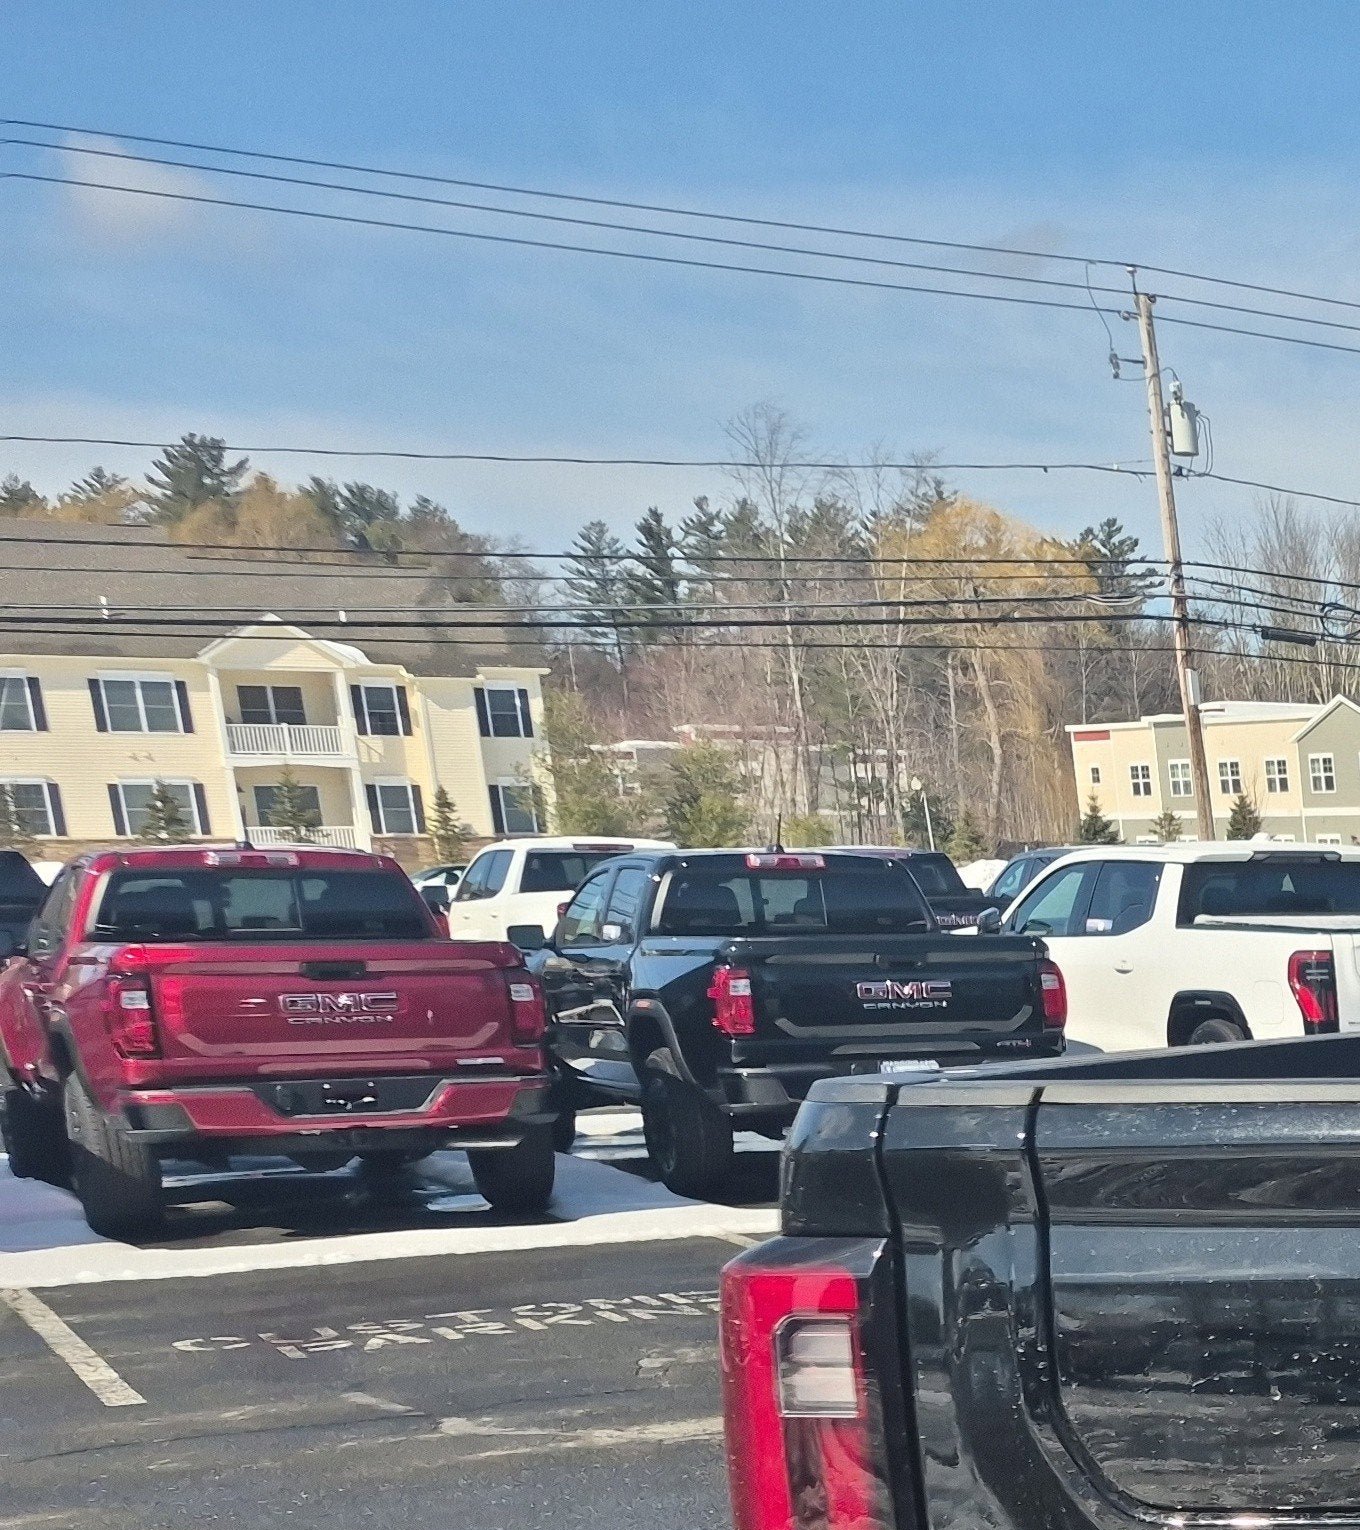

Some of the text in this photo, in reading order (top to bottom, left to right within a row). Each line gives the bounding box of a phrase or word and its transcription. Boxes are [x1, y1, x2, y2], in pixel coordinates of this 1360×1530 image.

[856, 980, 953, 1000] GMC
[278, 991, 398, 1013] GMC
[863, 1000, 948, 1010] CANYON
[286, 1015, 394, 1025] CANYON
[171, 1289, 720, 1351] CUSTOME
[276, 1302, 720, 1359] PARKIN
